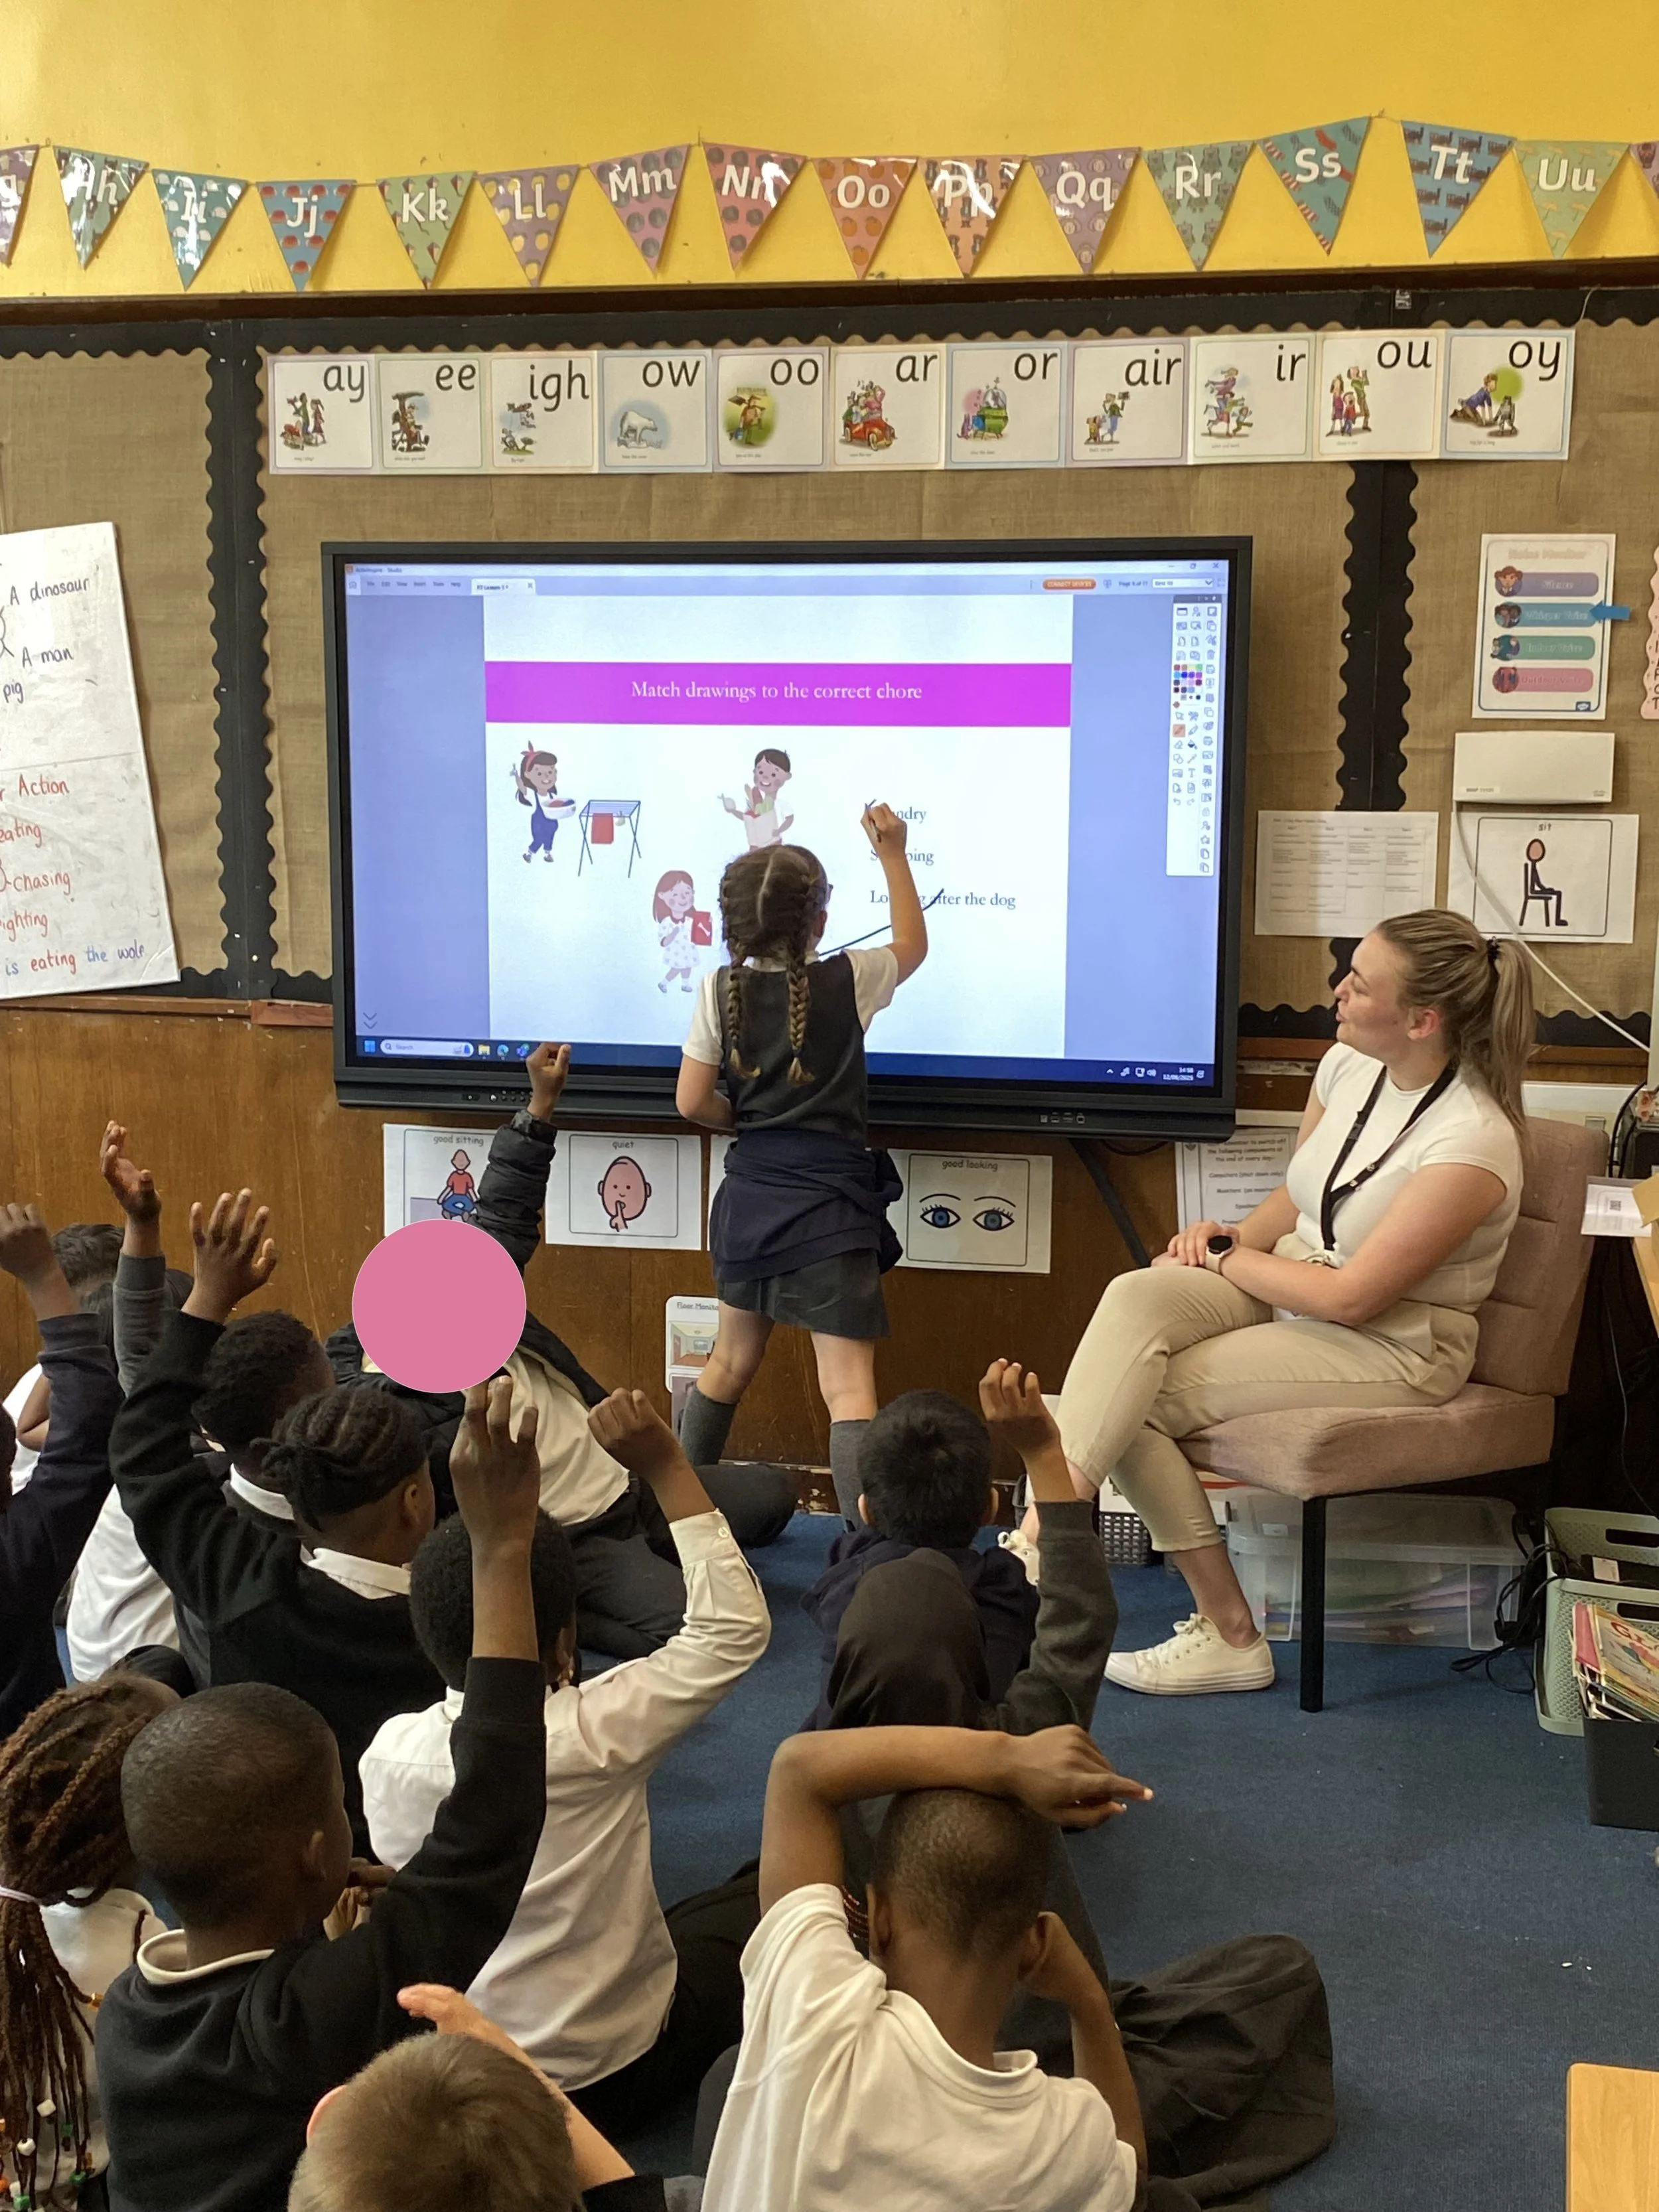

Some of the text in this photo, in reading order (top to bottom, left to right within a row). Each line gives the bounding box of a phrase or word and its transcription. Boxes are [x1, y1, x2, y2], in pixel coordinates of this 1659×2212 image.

[1295, 147, 1342, 183] Ss
[1431, 145, 1474, 184] Tt
[1538, 159, 1597, 192] Uu
[609, 167, 676, 202] Mm
[837, 175, 890, 208] Oo
[944, 175, 993, 217] Pp
[1056, 171, 1115, 211] Qq
[1175, 165, 1222, 200] Rr
[180, 190, 207, 223] Ii
[287, 194, 319, 238] Jj
[402, 188, 449, 223] Kk
[514, 184, 546, 220] Ll
[896, 355, 938, 382] ar
[1014, 352, 1058, 380] or
[1125, 348, 1182, 386] air
[1276, 344, 1307, 381] ir
[1378, 341, 1432, 368] ou
[1509, 340, 1561, 382] oy
[323, 365, 364, 403] ay
[435, 364, 476, 391] ee
[530, 360, 590, 412] igh
[642, 360, 701, 388] ow
[770, 358, 819, 386] oo
[10, 578, 90, 606] A dinosaur
[22, 647, 74, 668] A man
[3, 680, 23, 703] pig
[631, 680, 922, 703] Match drawings to the correct chore
[19, 773, 70, 797] Action
[1538, 822, 1551, 832] sit
[13, 871, 71, 896] chasing
[930, 891, 961, 905] after
[965, 892, 986, 905] the
[990, 893, 1016, 910] dog
[0, 910, 48, 942] ighting
[5, 938, 144, 976] is eating the wolf
[433, 1135, 484, 1147] good sitting
[612, 1141, 634, 1150] quiet
[942, 1159, 998, 1173] good looking
